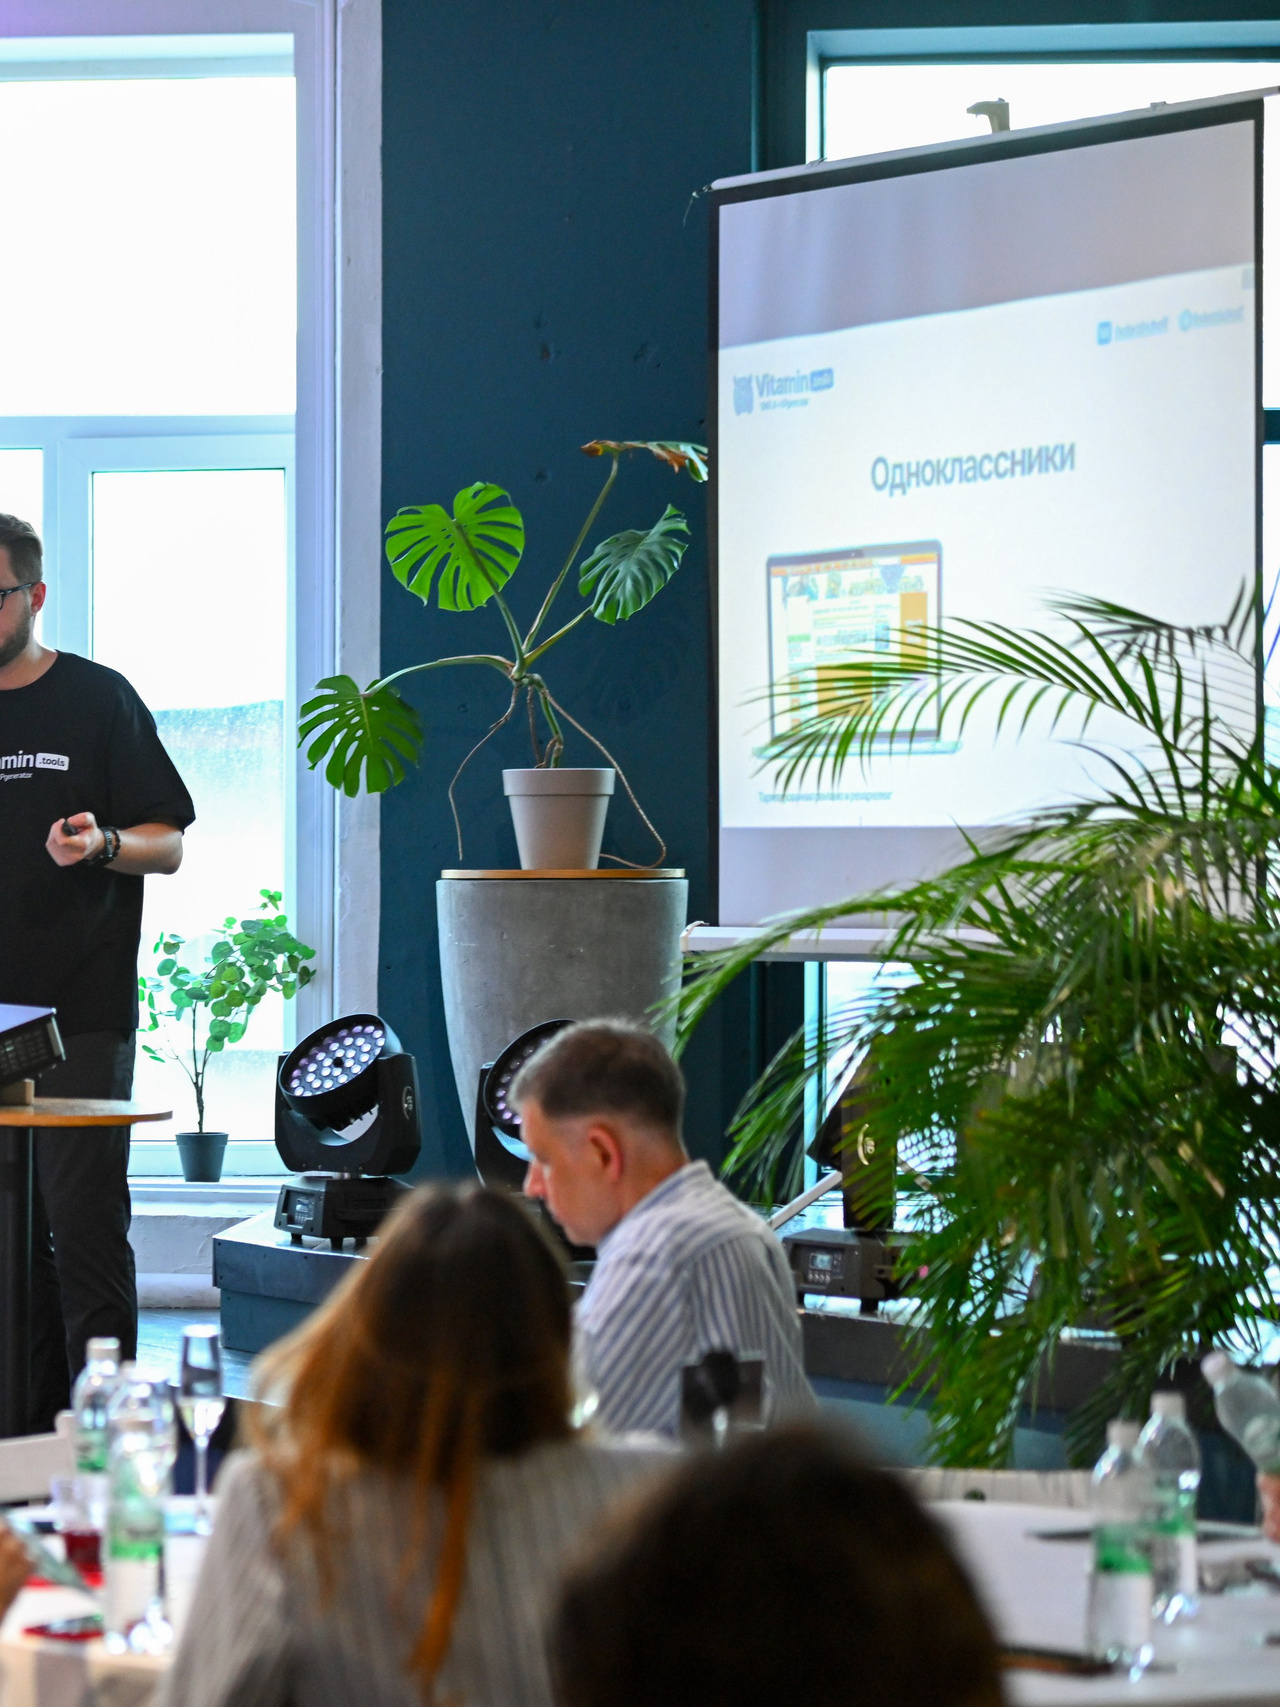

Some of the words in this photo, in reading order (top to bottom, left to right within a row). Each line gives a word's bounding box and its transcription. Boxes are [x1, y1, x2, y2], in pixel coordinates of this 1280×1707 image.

[756, 369, 809, 398] Vitamin
[871, 442, 1076, 497] Одноклассники
[39, 757, 66, 767] .tools
